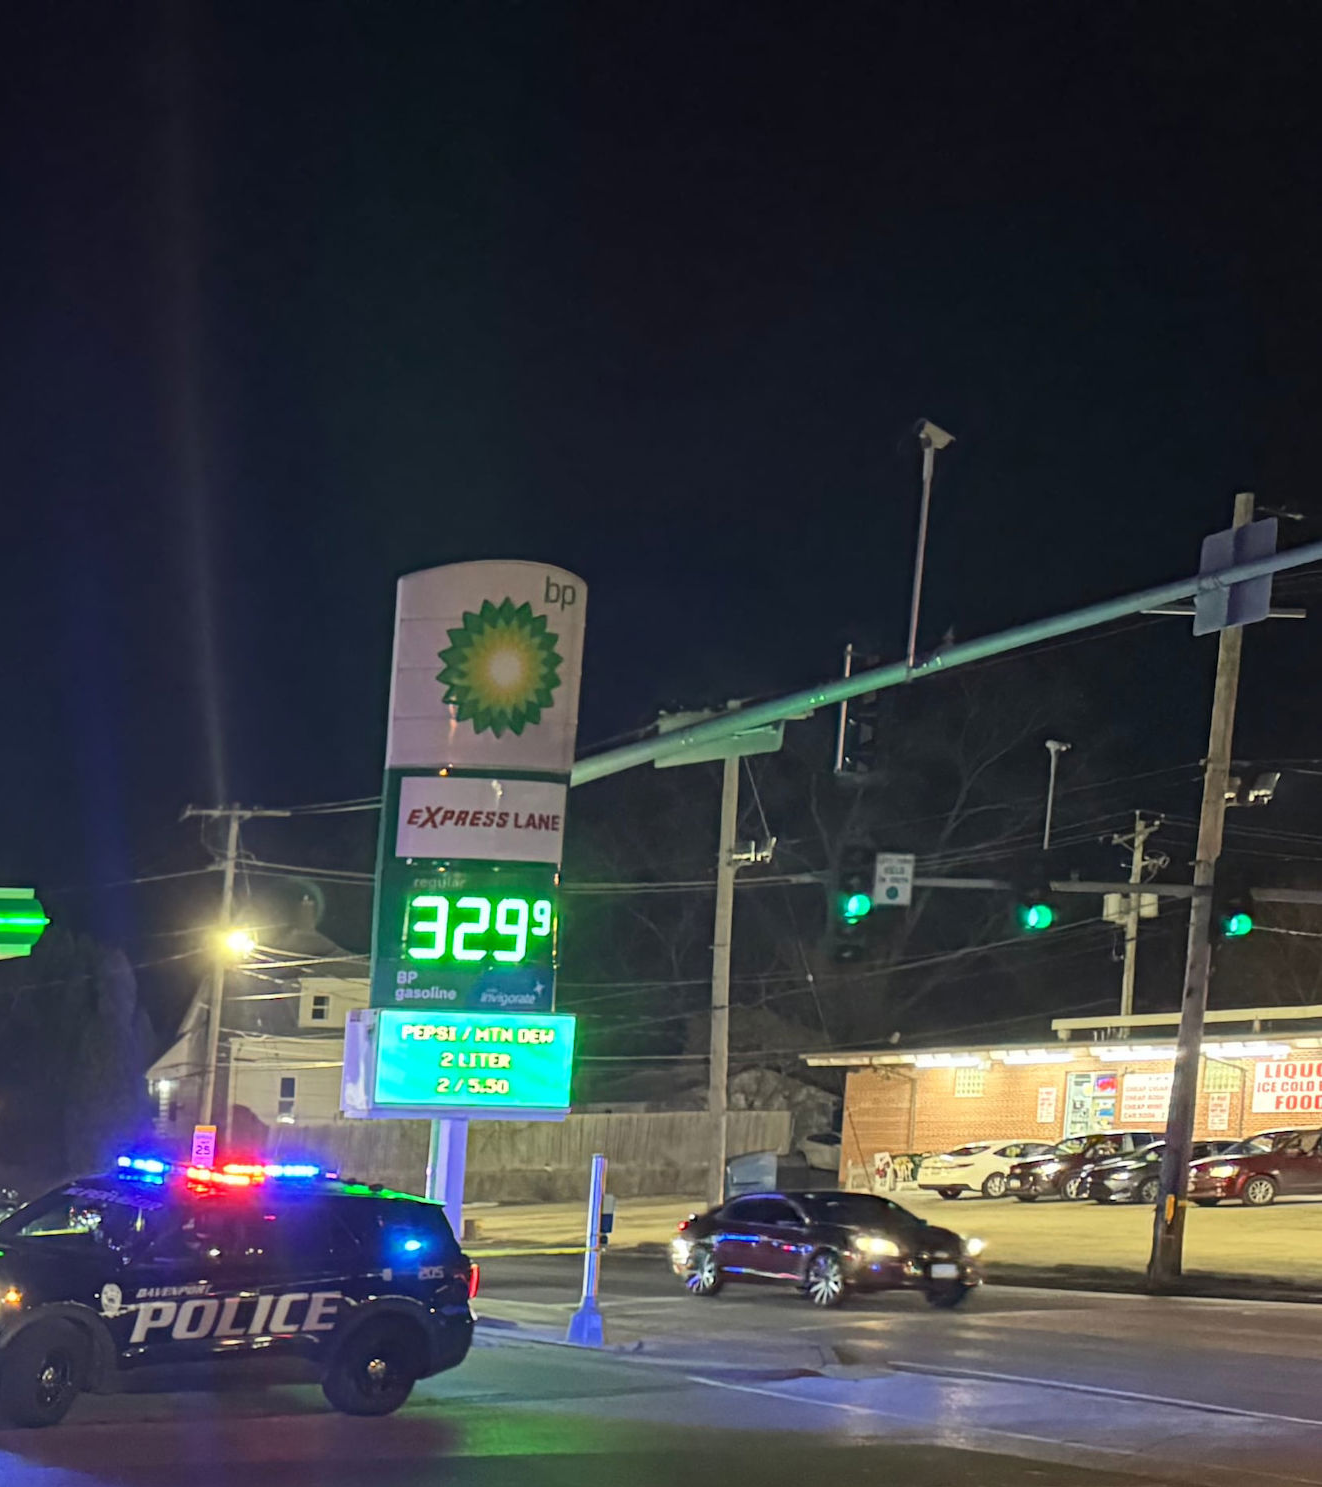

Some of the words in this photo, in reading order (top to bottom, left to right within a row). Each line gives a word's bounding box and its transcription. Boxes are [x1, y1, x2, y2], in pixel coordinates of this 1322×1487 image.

[544, 576, 576, 611] bp
[406, 806, 510, 829] EXPRESS
[513, 811, 560, 831] LANE
[413, 875, 466, 891] regular
[396, 971, 418, 985] BP
[395, 986, 457, 1001] gasoline
[401, 1025, 456, 1042] PEPSI
[474, 1027, 513, 1043] MTN
[517, 1029, 555, 1044] DEW
[440, 1052, 453, 1067] 2
[458, 1053, 511, 1068] LITER
[436, 1078, 450, 1093] 2
[468, 1078, 509, 1094] 5.50
[1257, 1082, 1277, 1093] ICE
[1280, 1081, 1315, 1092] COLD
[196, 1145, 210, 1155] 25
[129, 1291, 342, 1343] POLICE
